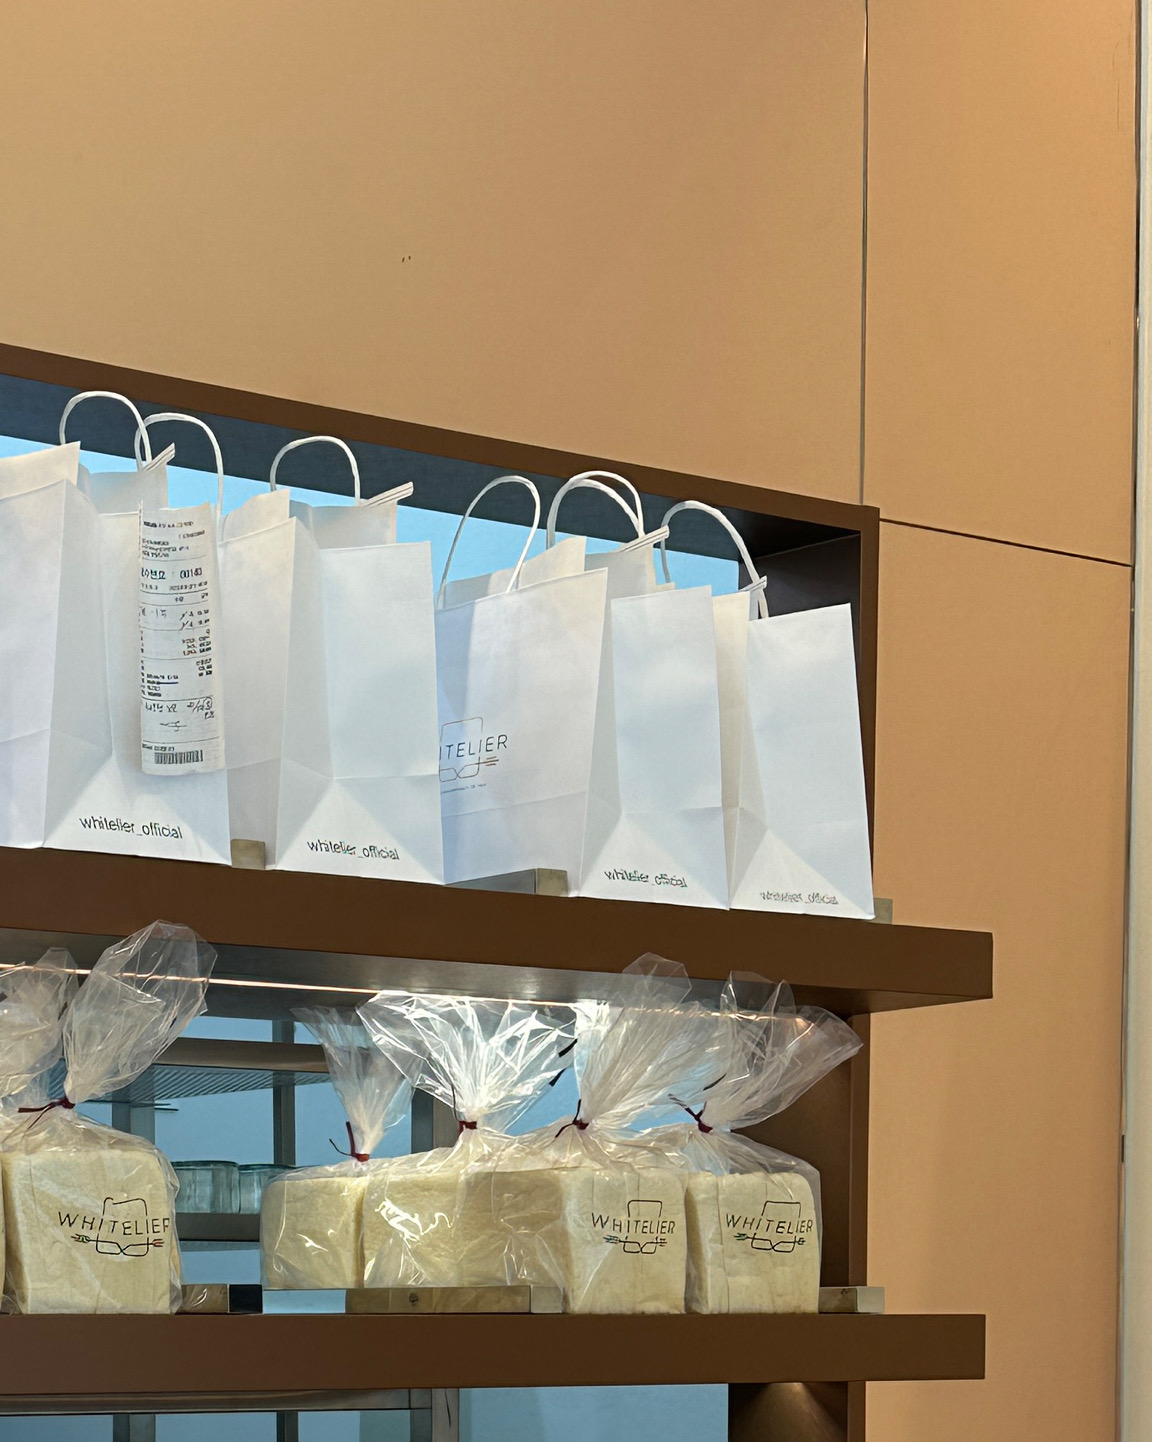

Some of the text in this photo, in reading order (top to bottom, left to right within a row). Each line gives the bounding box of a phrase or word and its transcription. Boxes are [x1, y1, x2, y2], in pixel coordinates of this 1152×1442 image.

[438, 734, 508, 761] ITELIER
[591, 1212, 676, 1235] WHITELIER
[725, 1212, 813, 1235] WHITELIER
